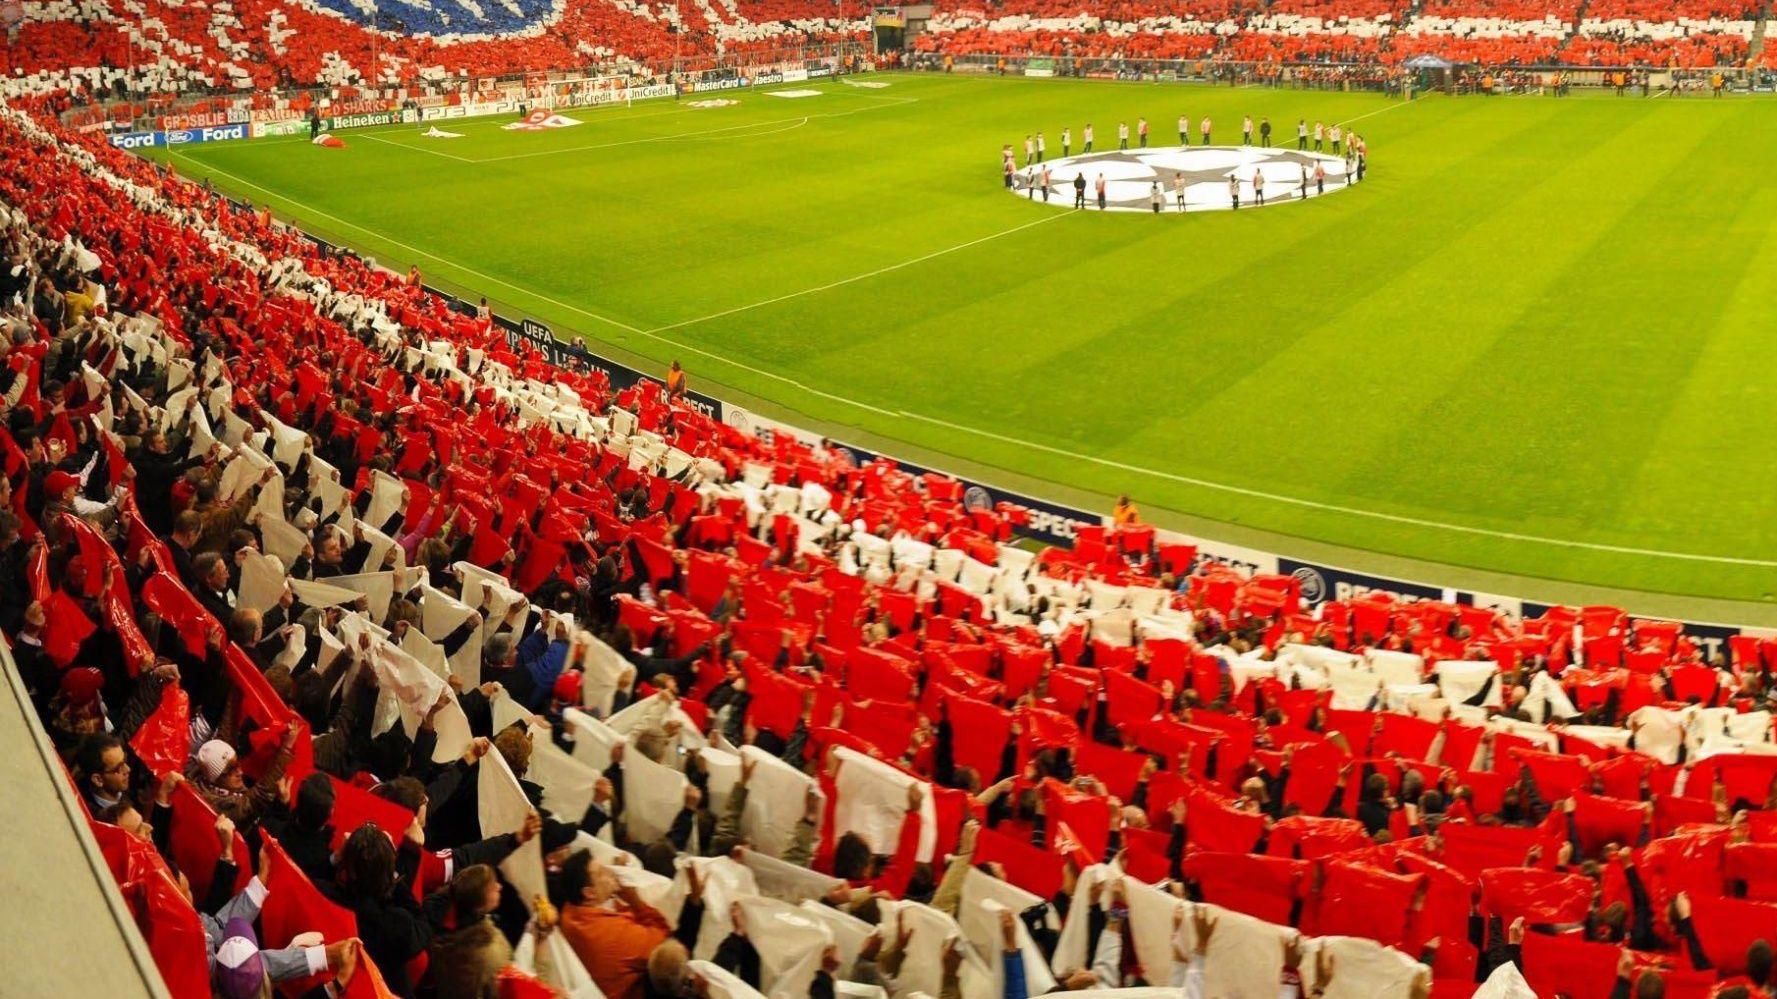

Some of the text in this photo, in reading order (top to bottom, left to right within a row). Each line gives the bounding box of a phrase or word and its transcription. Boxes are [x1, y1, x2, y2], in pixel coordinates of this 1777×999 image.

[694, 78, 739, 92] MasterCard
[343, 100, 388, 114] SHARKS
[333, 114, 390, 129] Heineken
[112, 133, 155, 148] Ford
[202, 126, 242, 141] Ford
[523, 322, 553, 344] UEFA
